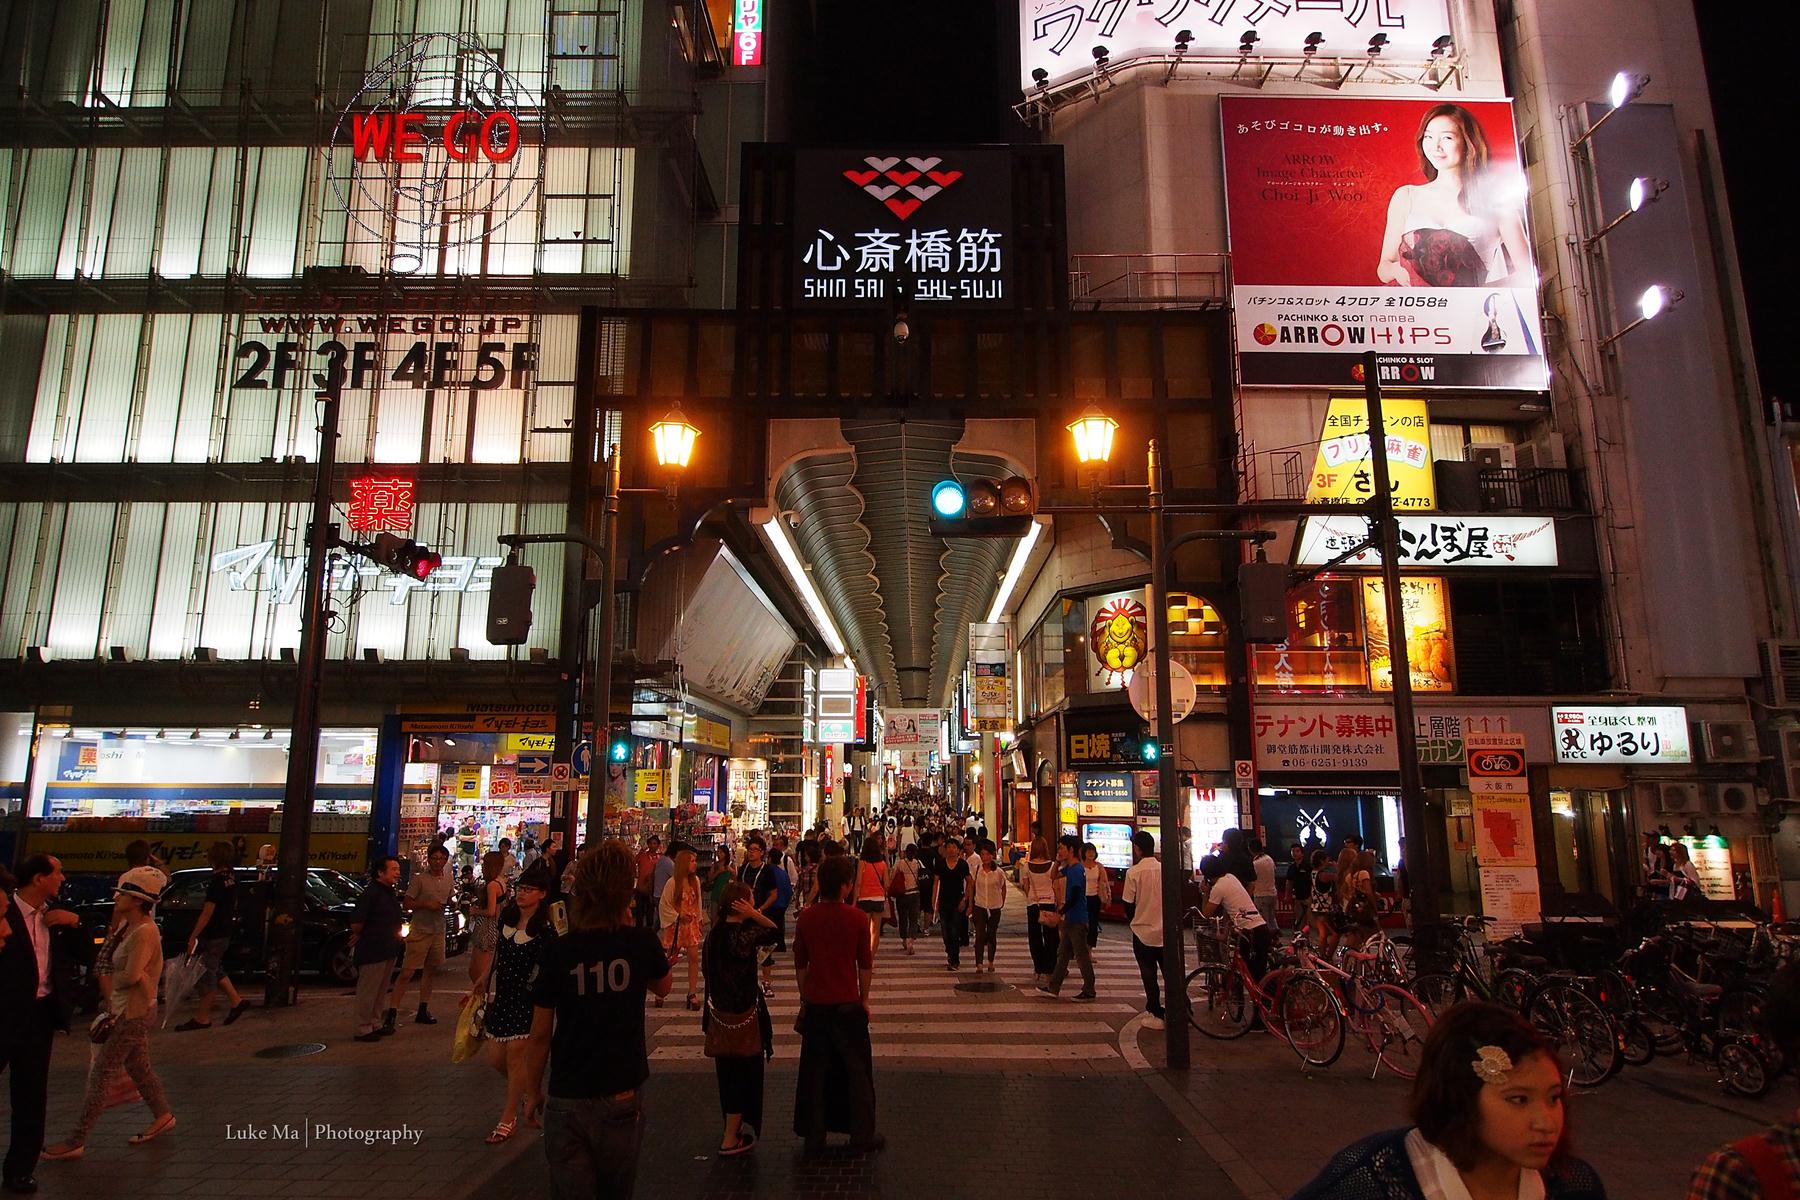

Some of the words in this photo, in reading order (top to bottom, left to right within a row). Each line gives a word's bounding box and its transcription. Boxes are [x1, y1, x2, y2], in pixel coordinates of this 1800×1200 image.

[739, 32, 757, 65] 6F
[353, 112, 426, 162] WE
[443, 112, 519, 162] GO
[1236, 119, 1389, 137] あそびゴコロが動き出す。
[1285, 153, 1337, 165] ARROW
[1257, 167, 1297, 180] Image
[1300, 167, 1365, 178] Character
[1261, 188, 1299, 201] Choi
[1306, 189, 1320, 204] Ji
[1329, 188, 1363, 201] Woo
[802, 228, 1003, 274] 心斎橋筋
[804, 278, 846, 298] SHIN
[854, 278, 884, 298] SAI
[1335, 296, 1380, 307] 4フロア
[1384, 296, 1449, 308] 全1058台
[1277, 314, 1329, 322] PACHINKO
[1331, 314, 1339, 322] &
[1342, 314, 1365, 322] SLOT
[1279, 323, 1366, 347] ARROW
[232, 341, 301, 389] 2F
[392, 342, 458, 389] 4F
[471, 342, 540, 390] 5F
[1378, 363, 1435, 382] RROW
[1327, 414, 1424, 428] 全国チンの店
[1327, 437, 1423, 463] フリ麻雀
[1316, 473, 1338, 489] 3F
[350, 478, 414, 532] 薬
[1256, 714, 1394, 738] テナント募集中
[1416, 716, 1461, 739] 上層階
[1071, 734, 1111, 759] 日焼
[1266, 743, 1385, 755] 御堂筋都市開発株式会社
[1589, 731, 1660, 757] ゆるり
[1292, 758, 1368, 768] 06-6251-9139
[1086, 779, 1124, 788] テナント募集
[1484, 782, 1514, 791] 大阪市
[569, 958, 631, 996] 110
